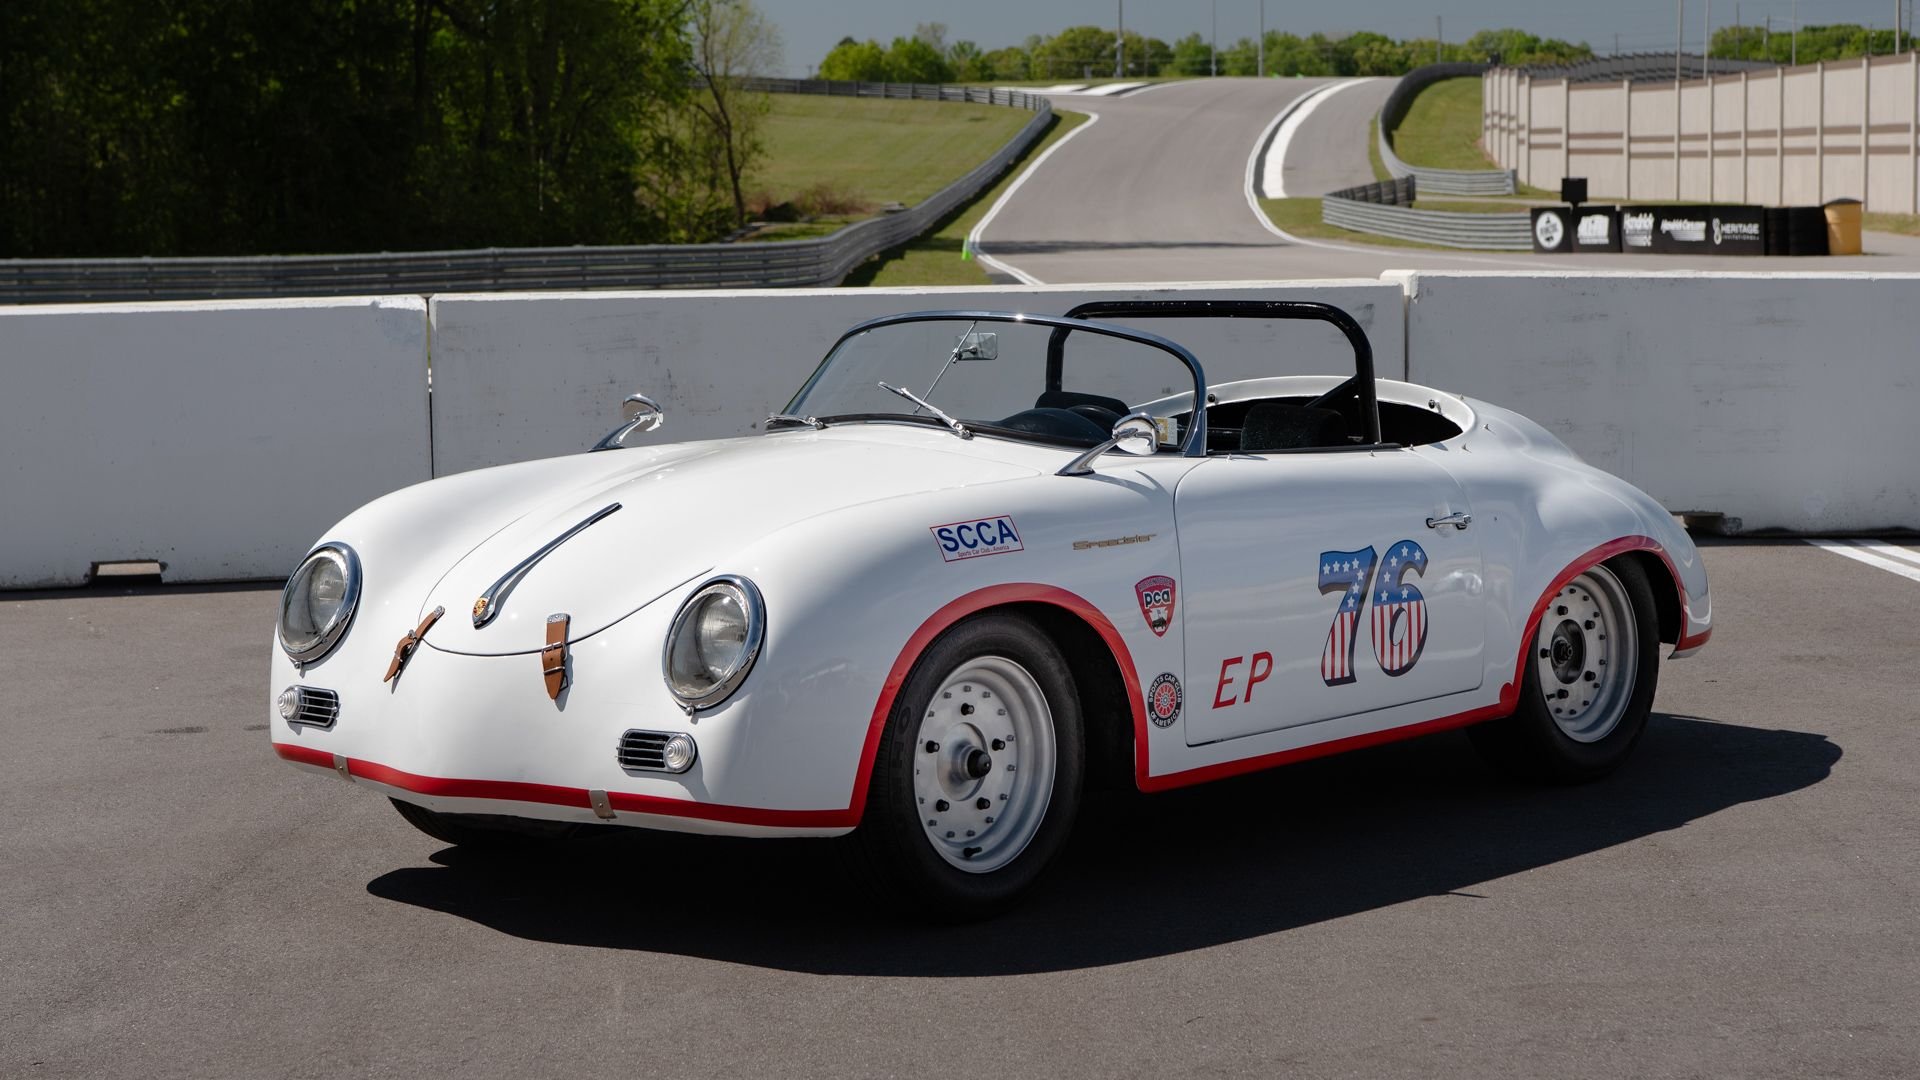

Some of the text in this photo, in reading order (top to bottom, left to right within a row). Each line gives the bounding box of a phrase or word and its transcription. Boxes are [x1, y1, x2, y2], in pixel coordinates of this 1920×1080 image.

[1721, 223, 1759, 234] HERITAGE
[937, 519, 1018, 552] SCCA
[1144, 589, 1171, 608] pca
[1318, 539, 1428, 687] 76
[1148, 674, 1182, 703] SPORTS CAR CLUB
[1212, 651, 1273, 709] EP
[1150, 709, 1180, 727] OF AMERICA
